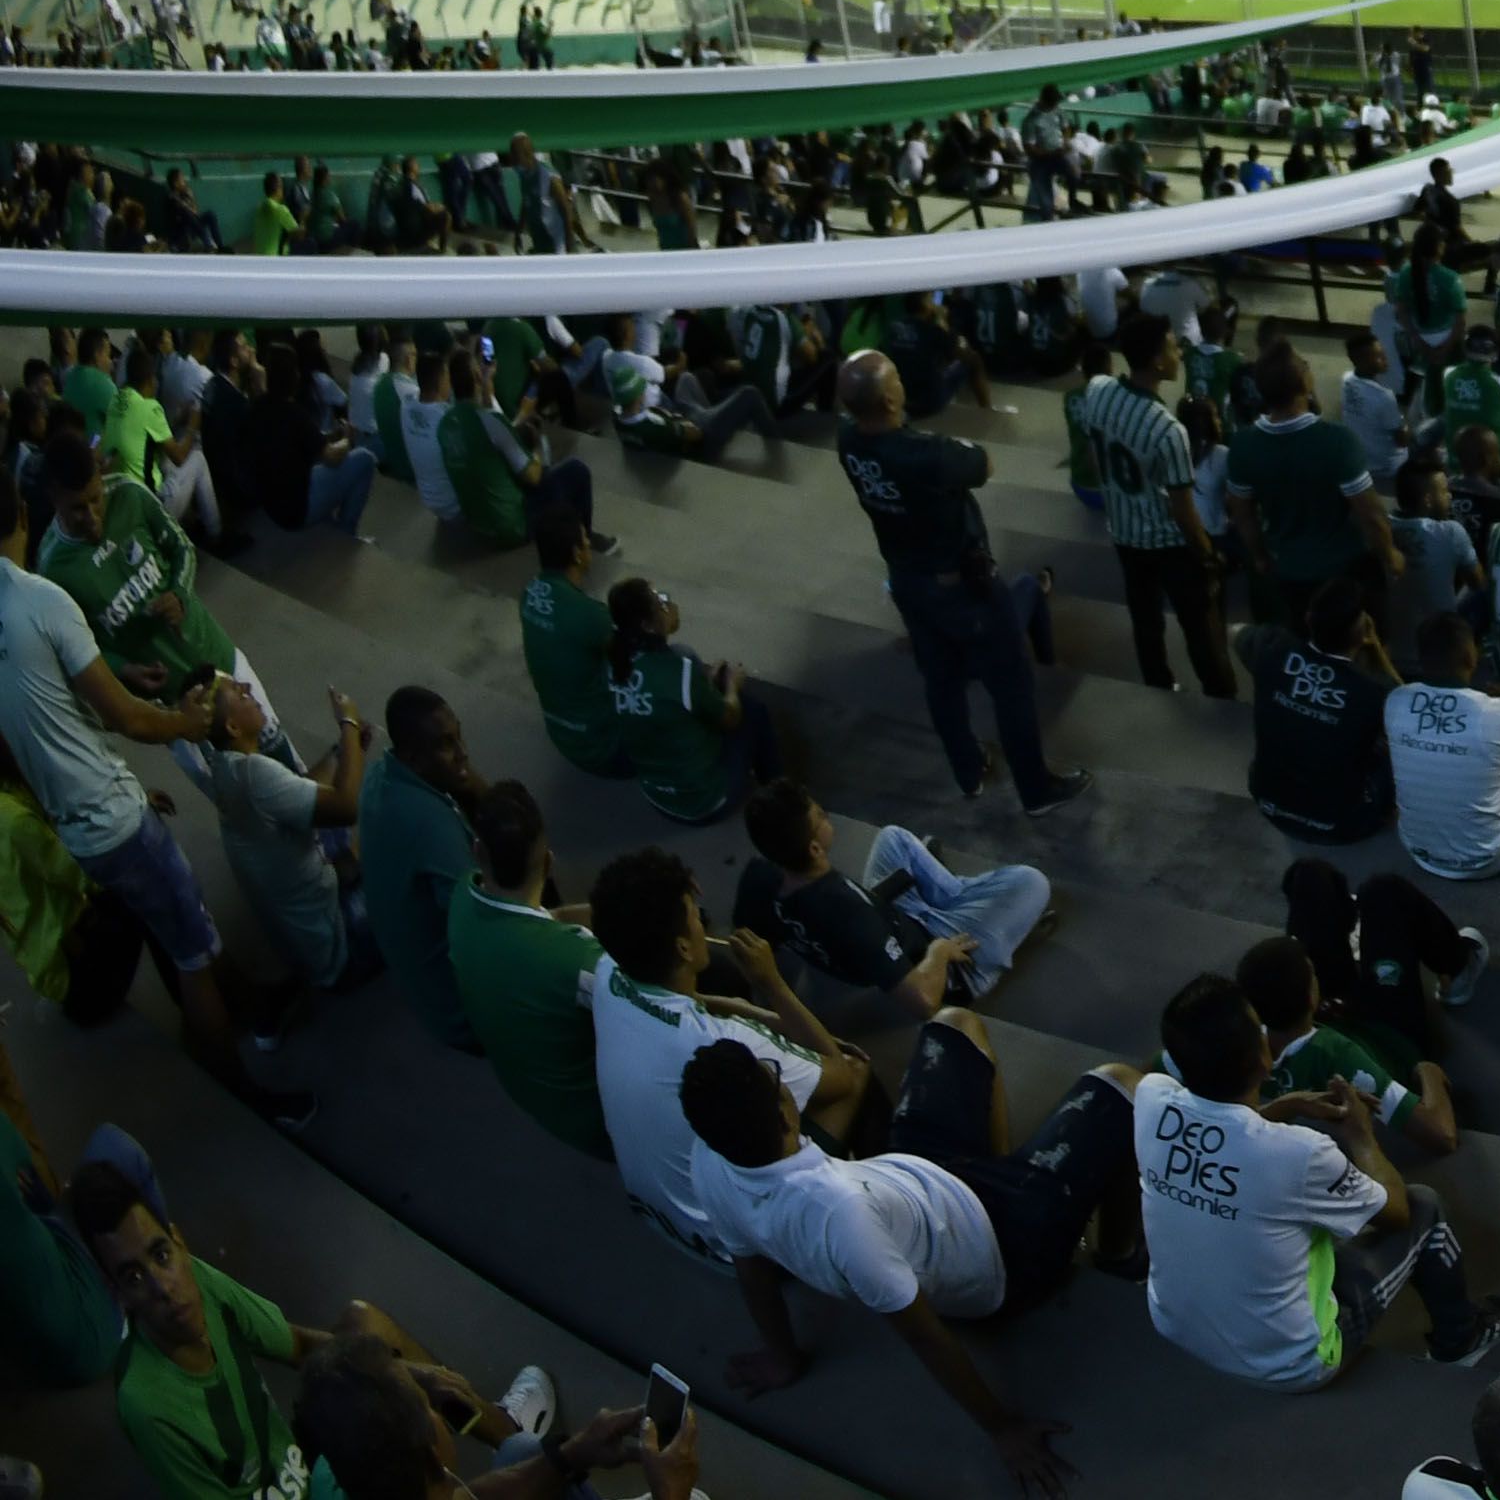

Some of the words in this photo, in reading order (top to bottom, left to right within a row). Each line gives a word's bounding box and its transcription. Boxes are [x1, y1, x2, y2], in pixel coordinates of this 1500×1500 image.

[1284, 653, 1336, 685] DEO
[1410, 692, 1458, 716] DEO
[1156, 1104, 1226, 1154] DEO
[1146, 1167, 1240, 1221] Recamier
